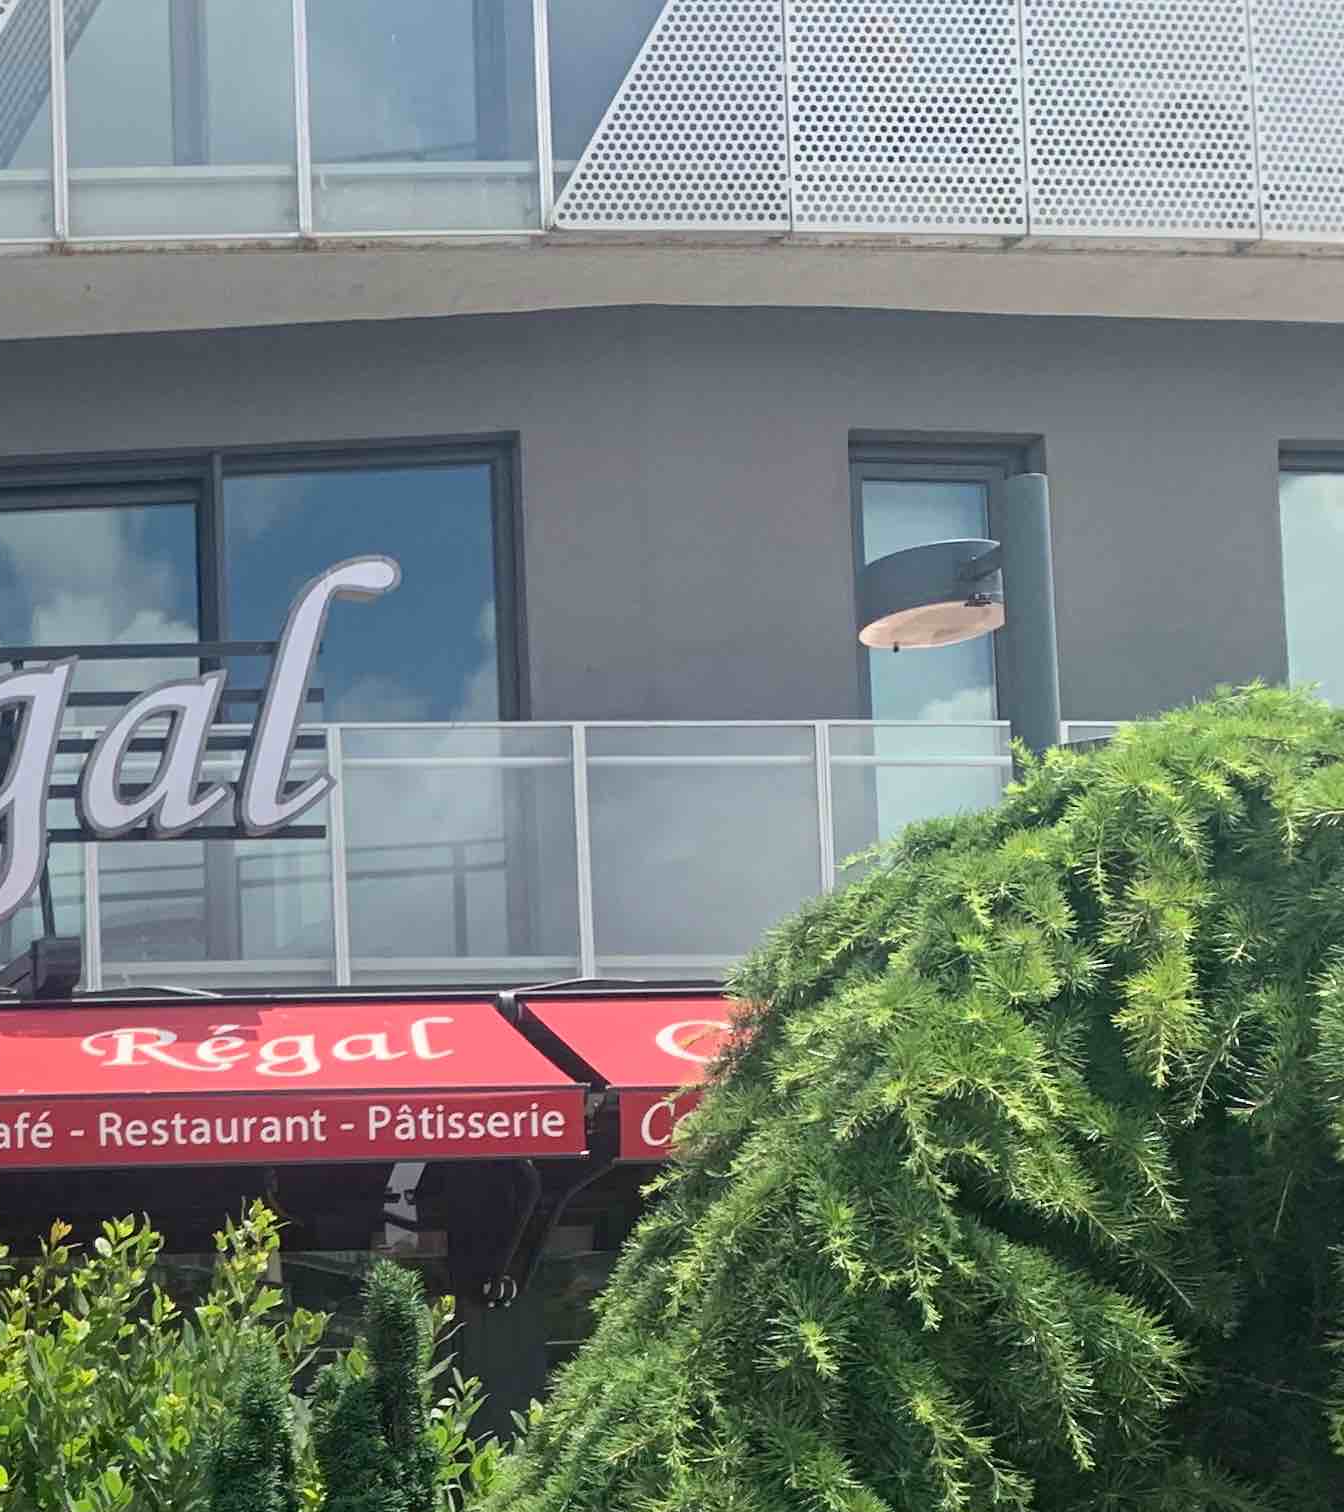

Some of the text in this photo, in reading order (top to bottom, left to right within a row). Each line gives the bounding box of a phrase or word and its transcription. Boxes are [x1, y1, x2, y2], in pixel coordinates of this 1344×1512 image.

[79, 1015, 455, 1077] Régal
[99, 1110, 327, 1147] Restaurant
[368, 1103, 566, 1141] Pâtisserie
